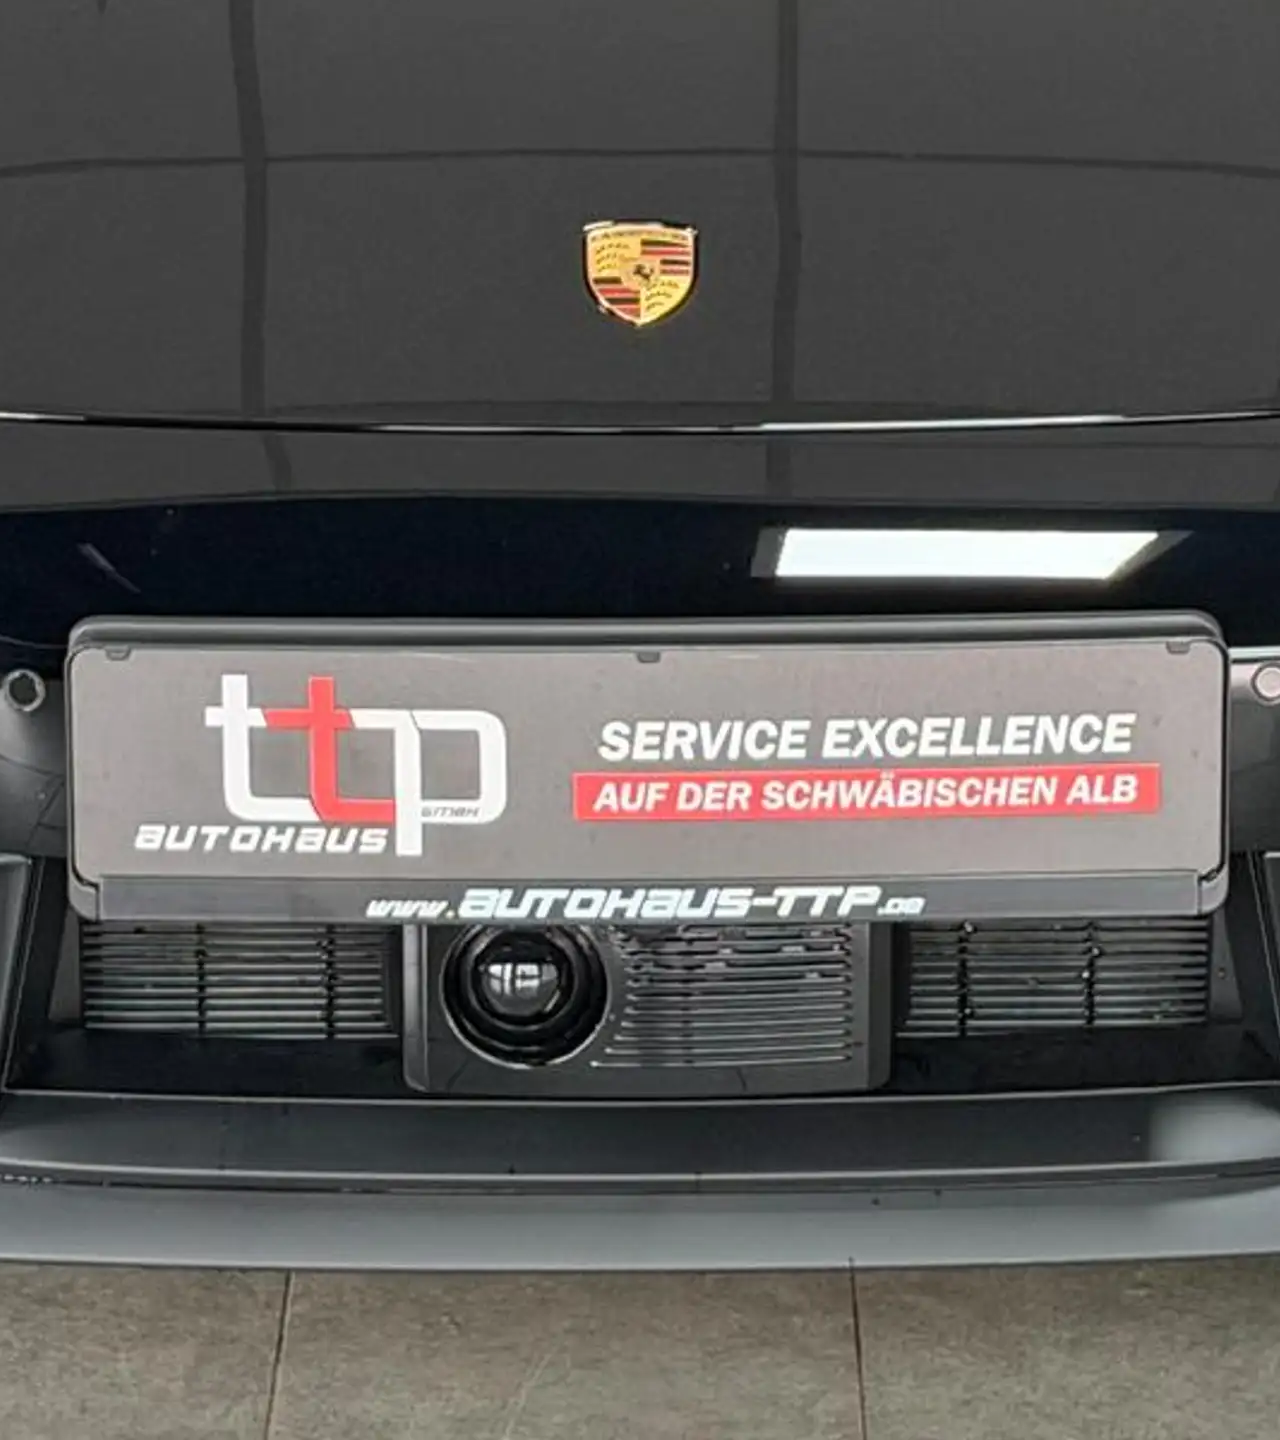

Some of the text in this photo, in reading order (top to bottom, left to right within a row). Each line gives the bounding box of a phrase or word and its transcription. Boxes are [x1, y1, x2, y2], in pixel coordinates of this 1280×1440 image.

[598, 713, 1137, 761] SERVICE EXCELLENCE
[593, 771, 1138, 812] AUF DER SCHWÄBISCHEN ALB
